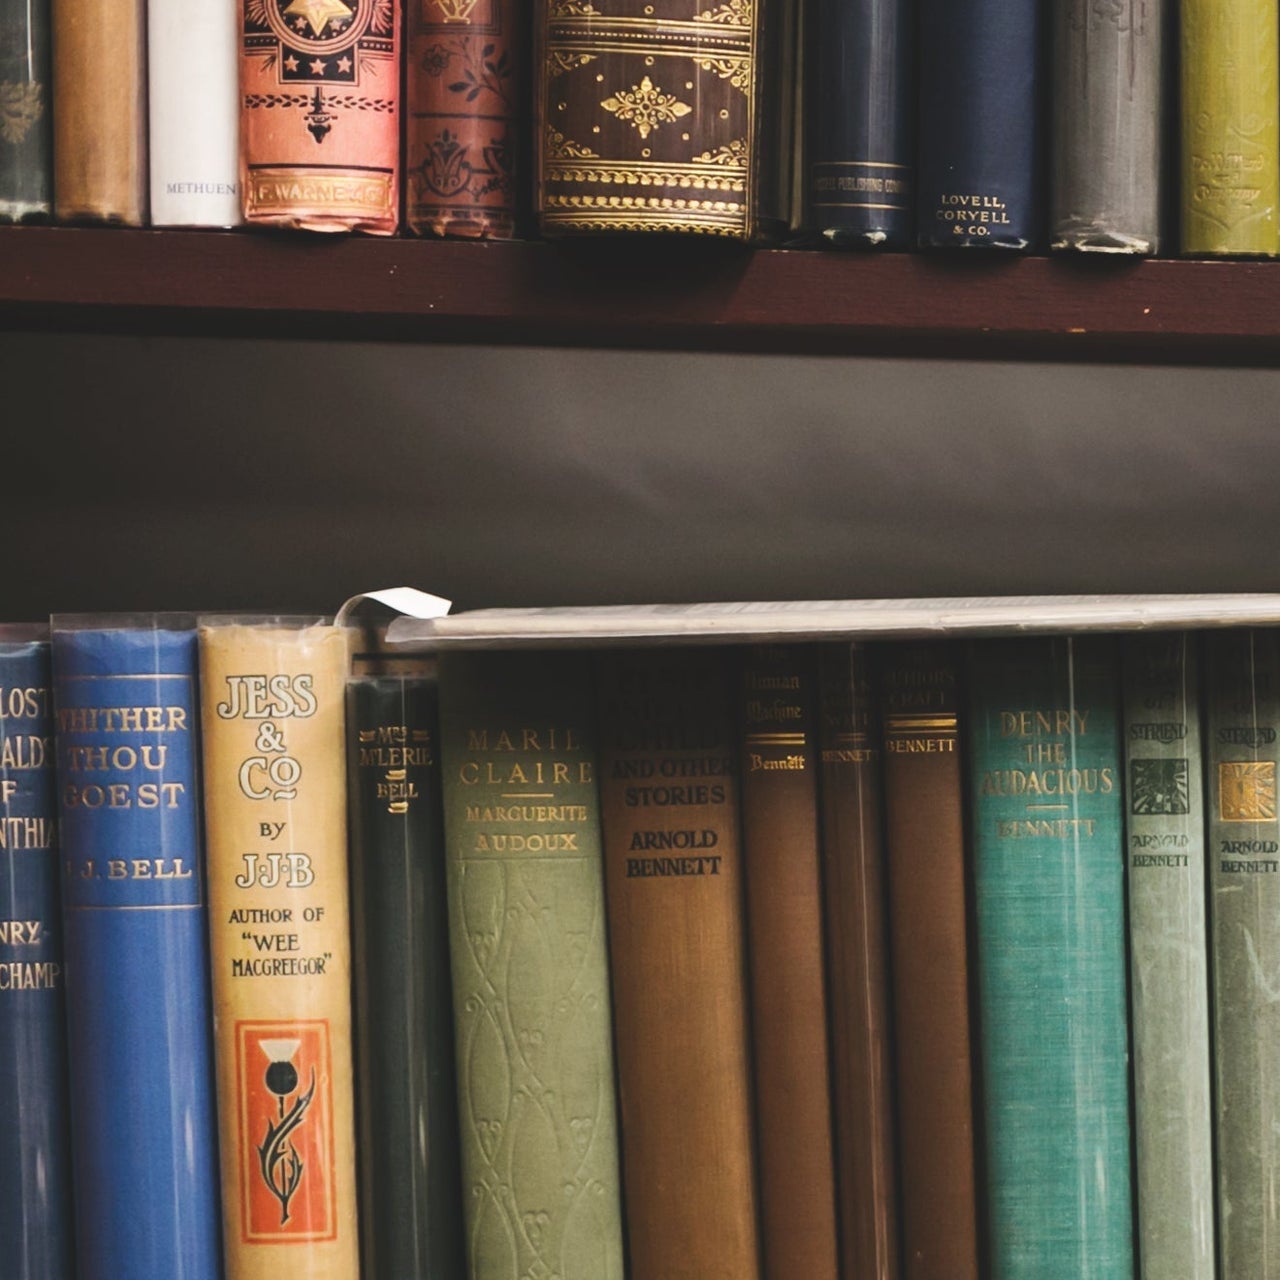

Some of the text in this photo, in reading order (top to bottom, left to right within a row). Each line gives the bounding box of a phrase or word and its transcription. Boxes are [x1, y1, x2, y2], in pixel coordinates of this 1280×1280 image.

[166, 182, 235, 195] METHUEN
[941, 195, 1006, 208] LOVELL,
[936, 210, 1010, 224] CORYELL
[953, 225, 964, 235] &
[216, 674, 318, 719] JESS
[257, 721, 286, 753] &
[70, 745, 167, 770] THOU
[1025, 743, 1066, 764] THE
[460, 762, 593, 785] CLAIRE
[981, 769, 1113, 796] AUDACIOUS
[377, 783, 418, 798] BELL
[625, 785, 725, 808] STORIES
[466, 806, 588, 823] MARGUERITE
[474, 834, 578, 852] AUDOUX
[629, 830, 718, 851] ARNOLD
[1221, 840, 1278, 854] ARNOLD
[109, 859, 192, 879] BELL
[626, 856, 722, 878] BENNETT
[1221, 861, 1278, 874] BENNETT
[229, 908, 325, 922] AUTHOR OF
